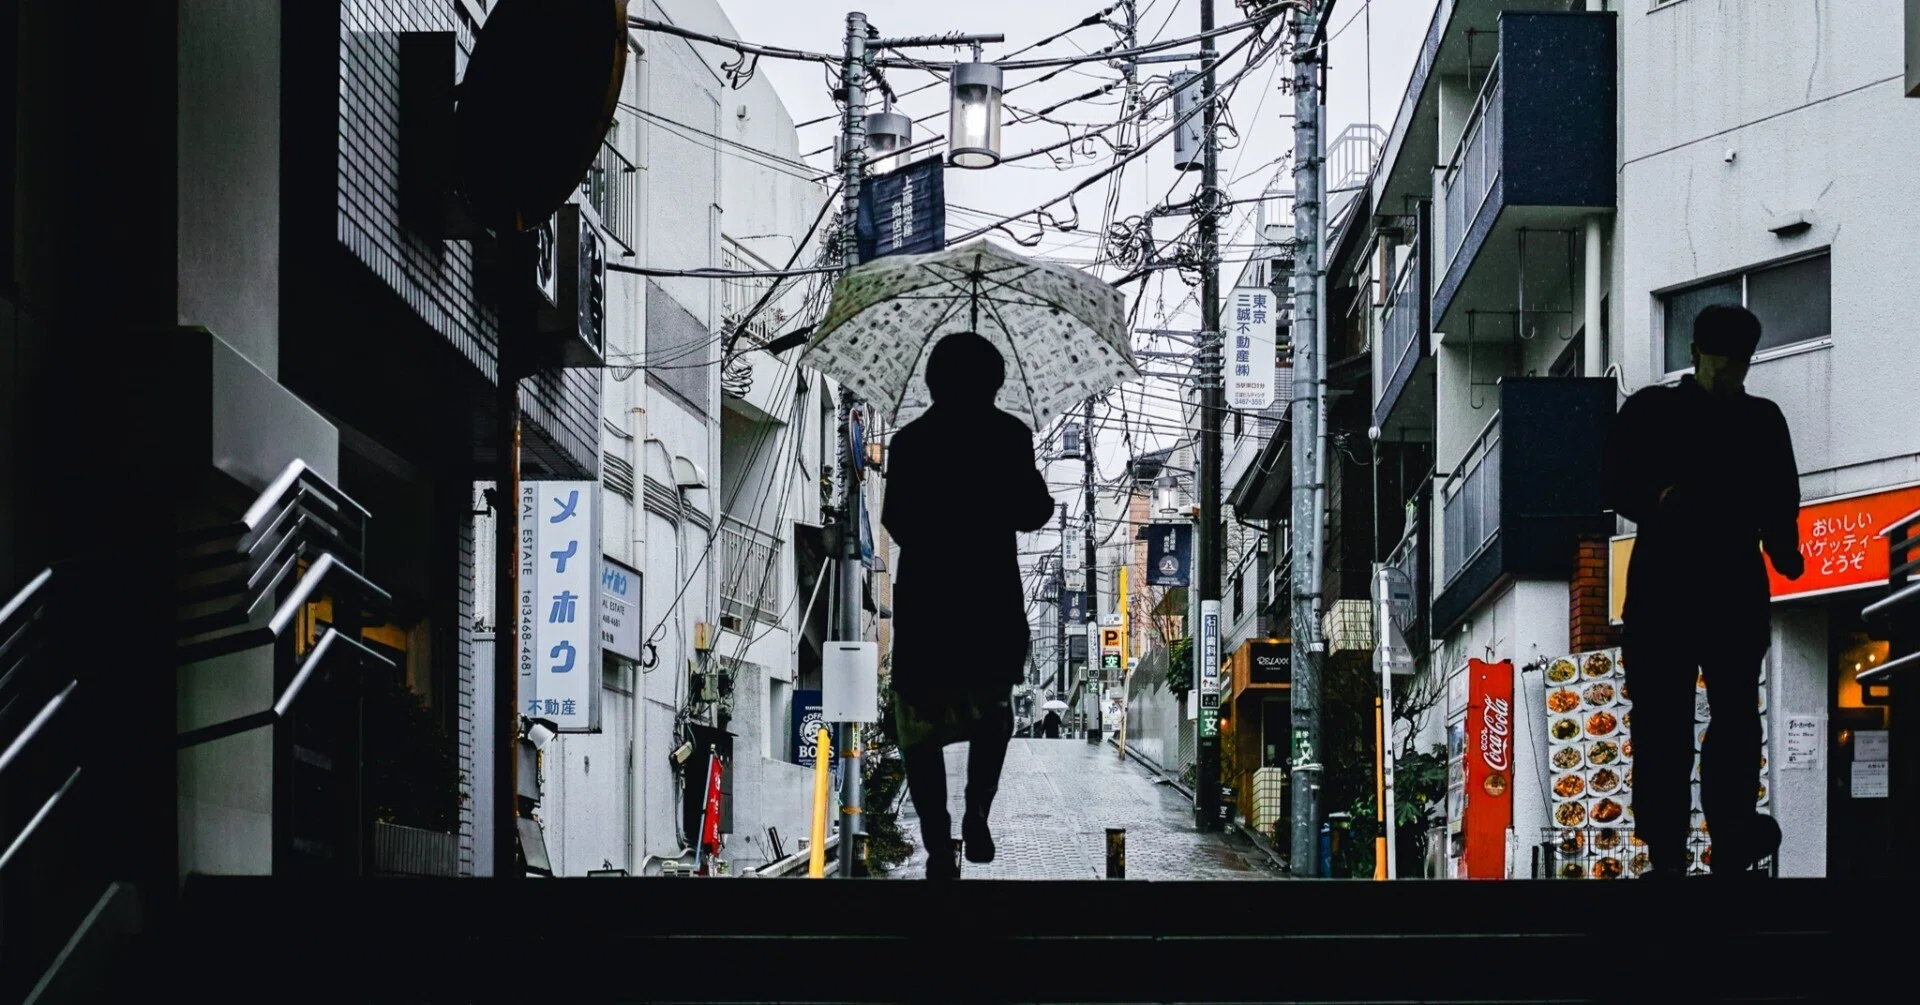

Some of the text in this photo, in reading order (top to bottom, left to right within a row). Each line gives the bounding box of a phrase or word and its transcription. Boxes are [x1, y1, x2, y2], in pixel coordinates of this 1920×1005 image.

[1252, 294, 1267, 324] 東京
[523, 487, 533, 521] REAL
[1812, 512, 1872, 537] おいしい
[522, 529, 533, 576] ESTATE
[1801, 535, 1882, 557] パゲッティー
[1821, 551, 1865, 575] どうぞ
[549, 490, 579, 674] メイホウ
[609, 602, 625, 615] ESTATE
[1105, 630, 1118, 646] P
[528, 698, 577, 716] 不動産
[803, 713, 823, 722] COFF
[1204, 717, 1218, 732] 文
[799, 745, 835, 758] BOS
